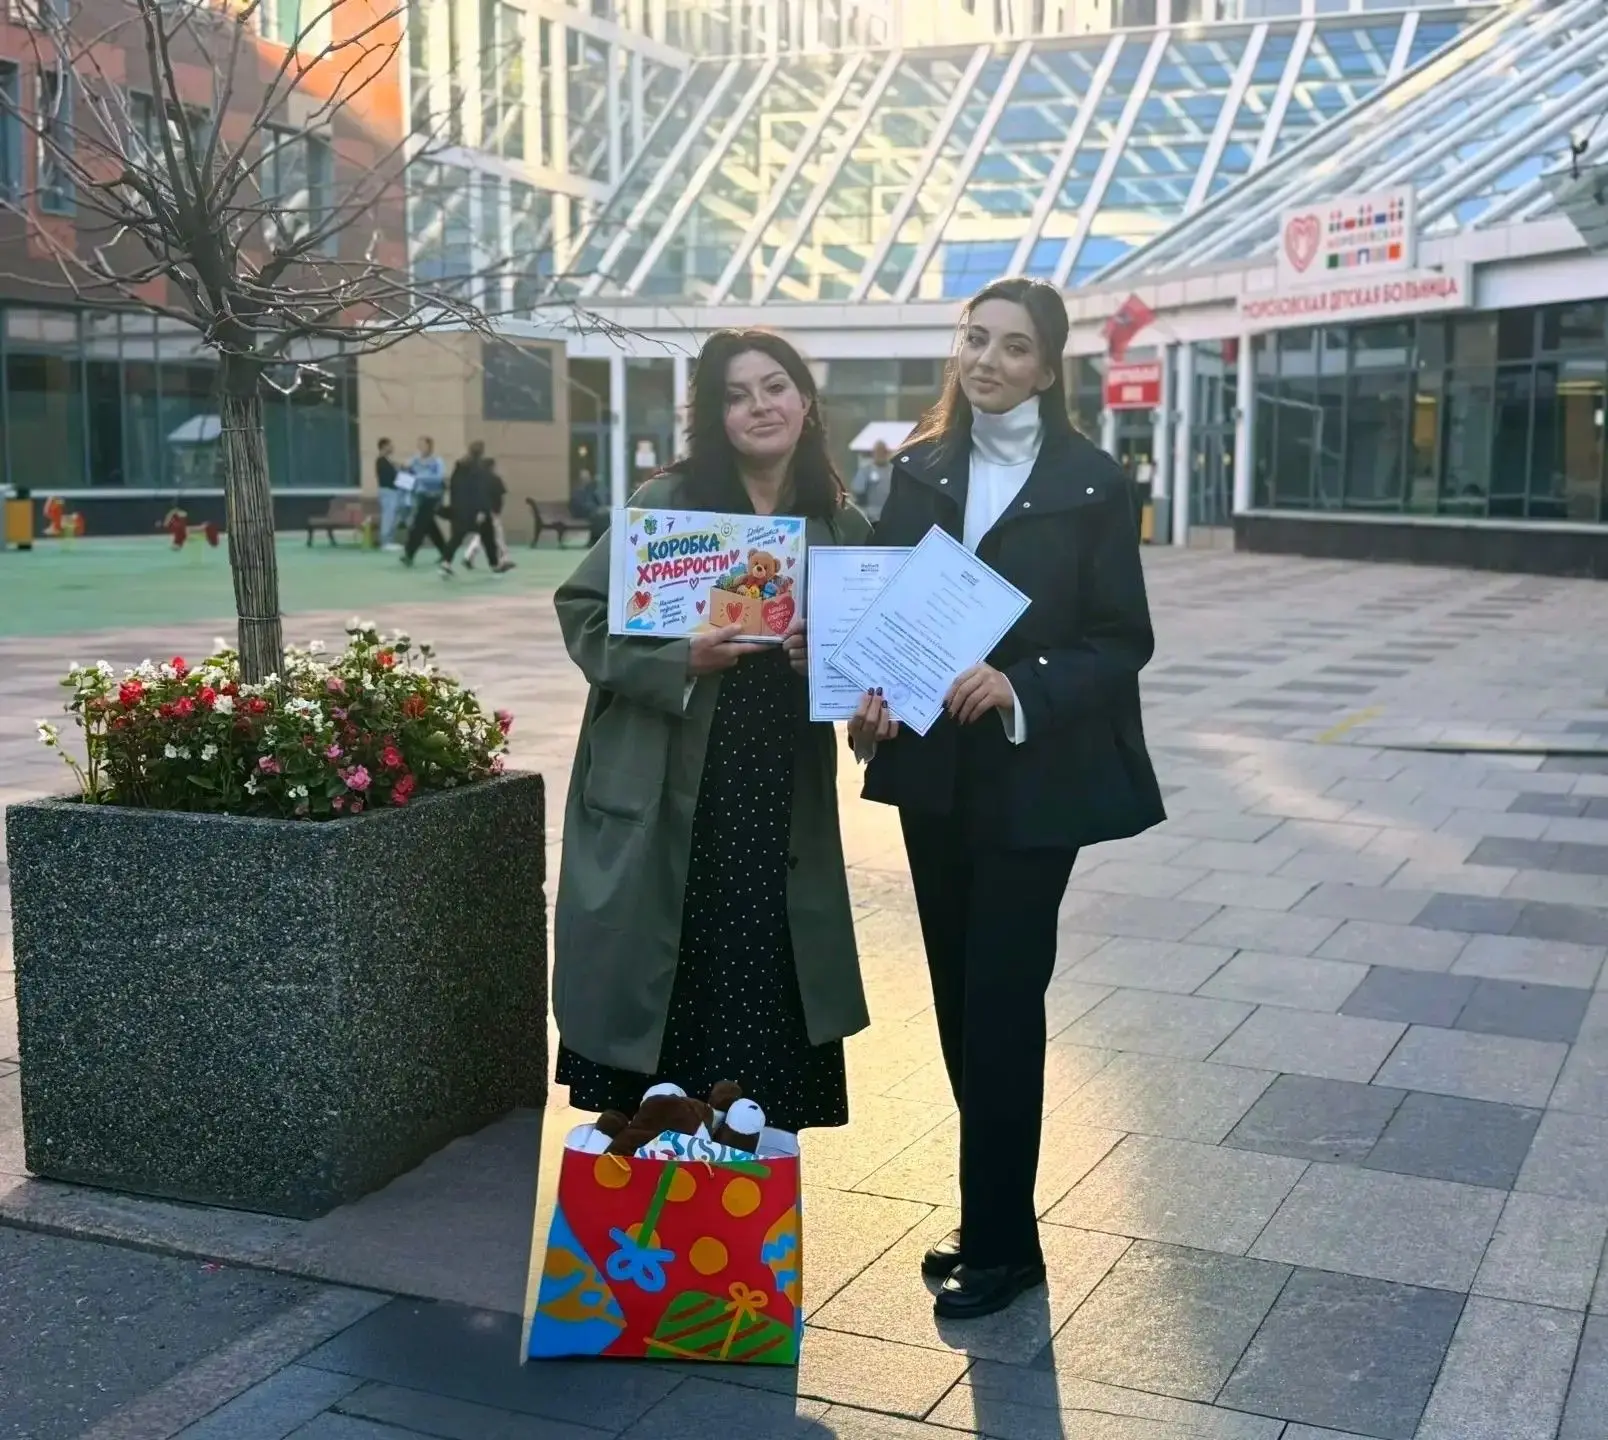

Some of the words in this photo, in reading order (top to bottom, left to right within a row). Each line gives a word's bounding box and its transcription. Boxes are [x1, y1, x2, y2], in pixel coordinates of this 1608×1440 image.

[1329, 285, 1379, 311] ДЕТСКАЯ
[1383, 276, 1458, 304] БОЛЬНИЦА
[647, 533, 720, 562] КОРОБКА
[637, 556, 730, 586] ХРАБРОСТИ
